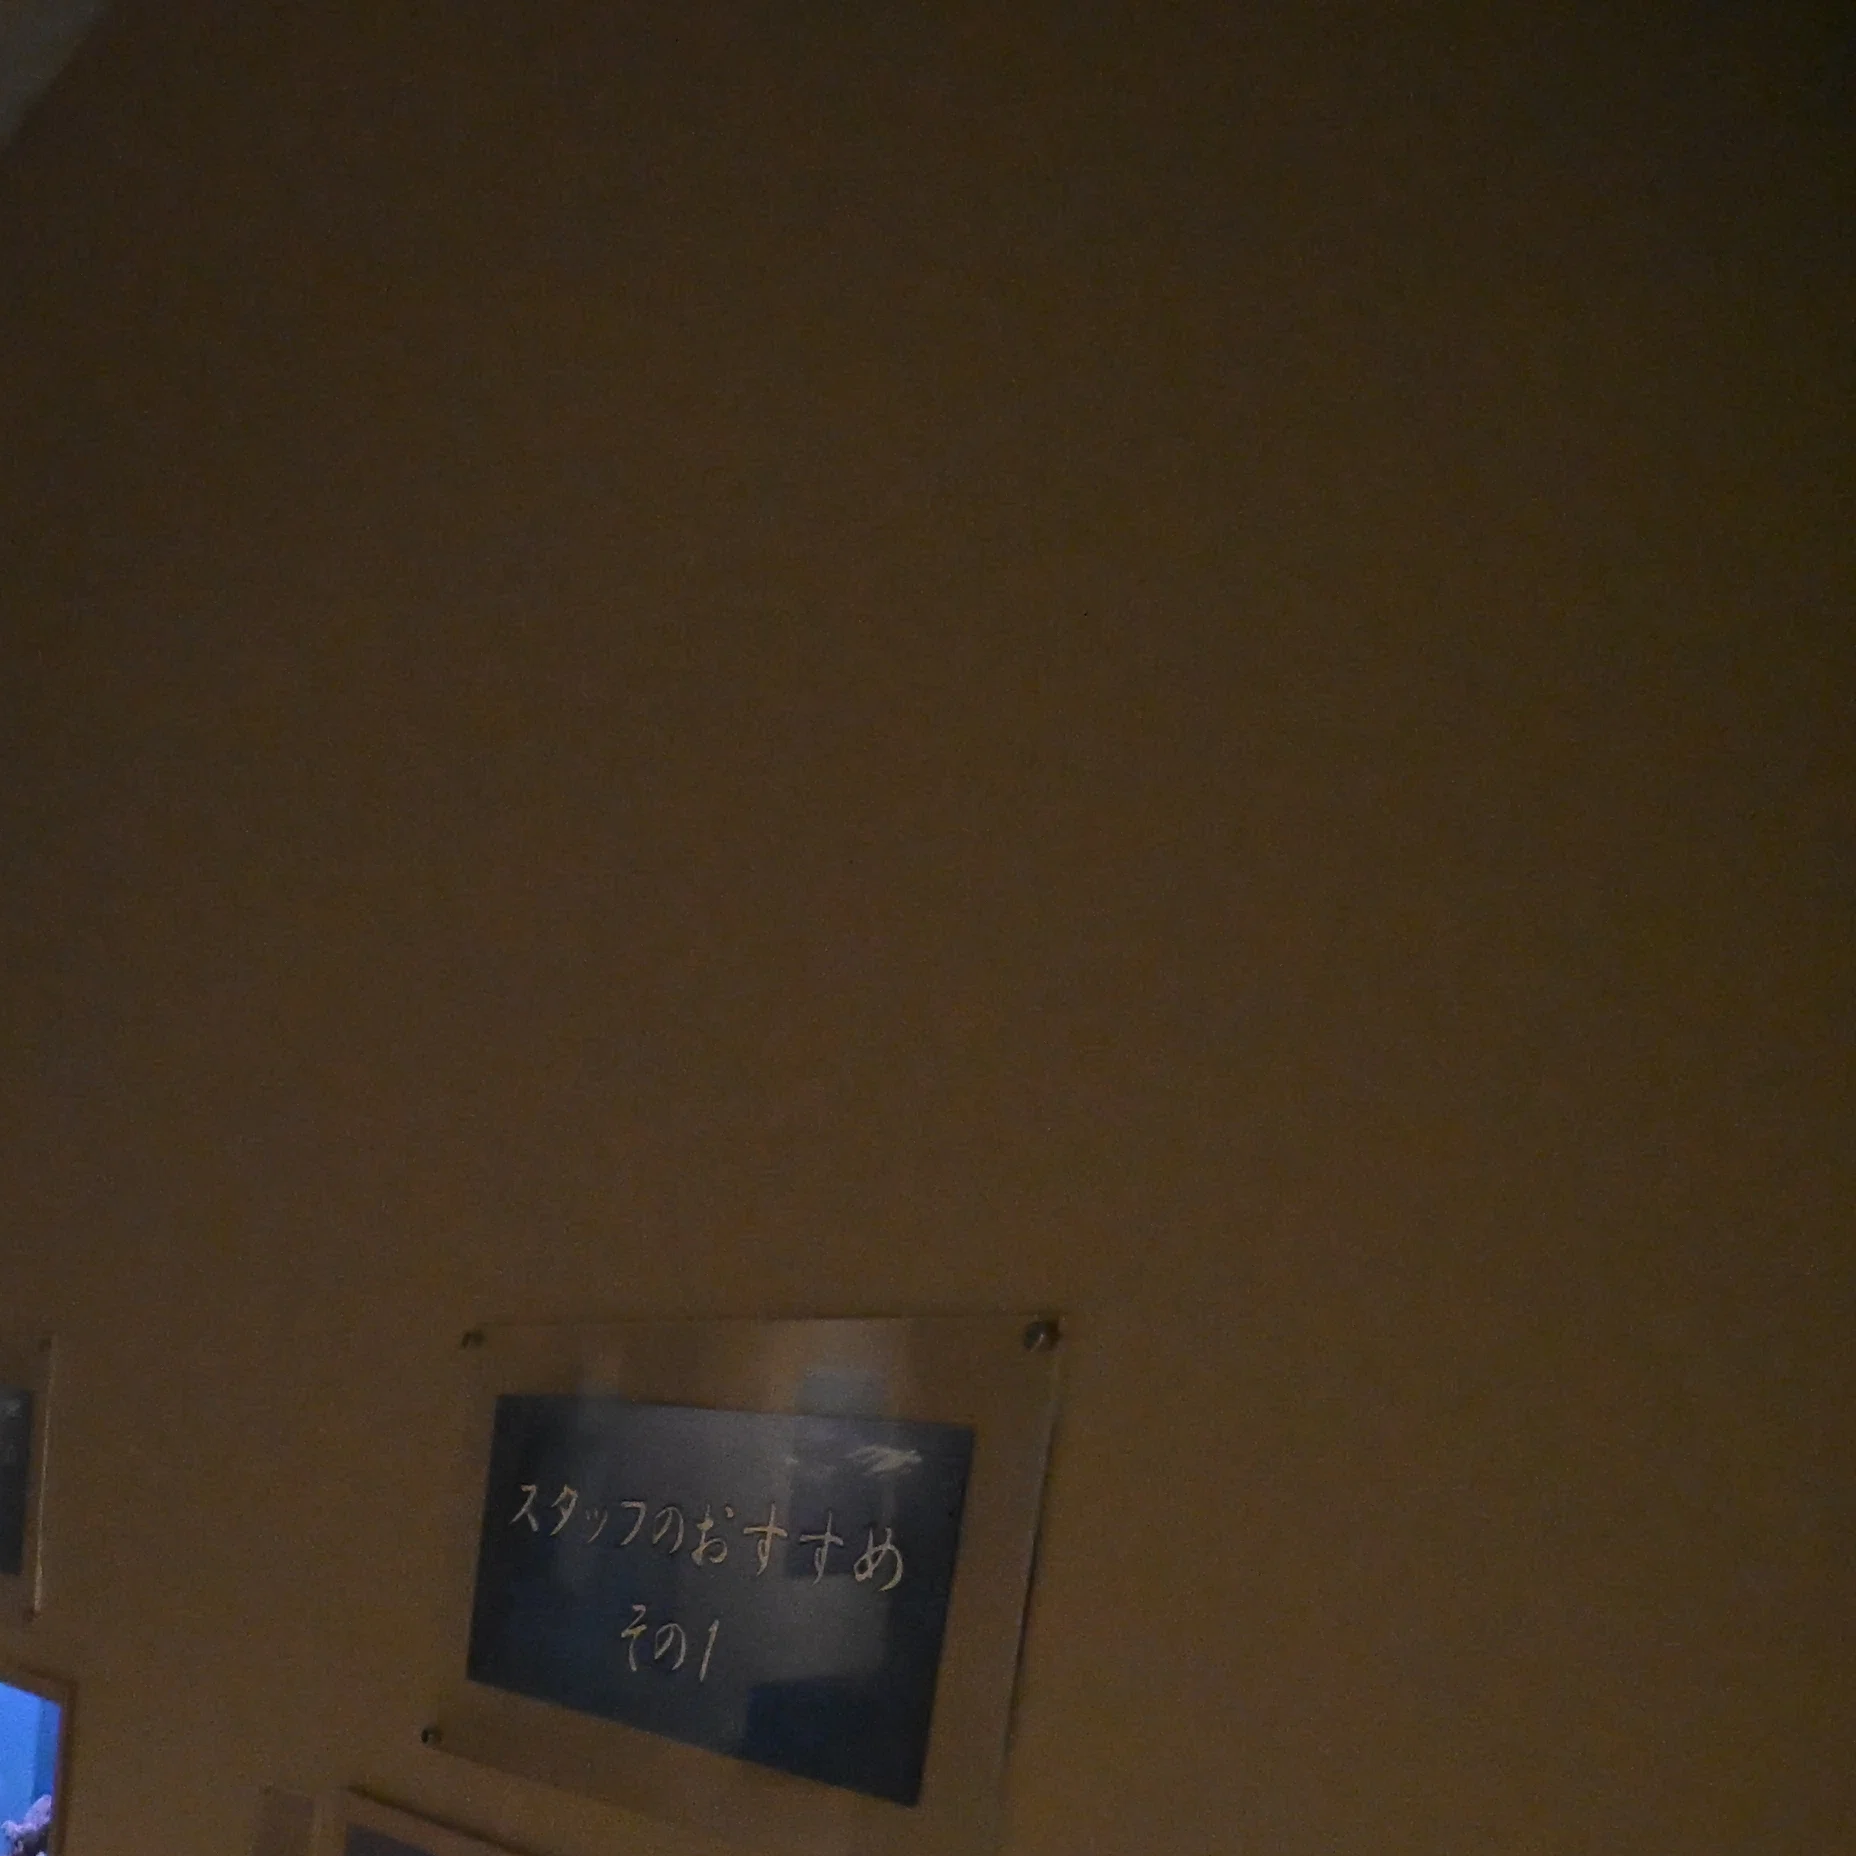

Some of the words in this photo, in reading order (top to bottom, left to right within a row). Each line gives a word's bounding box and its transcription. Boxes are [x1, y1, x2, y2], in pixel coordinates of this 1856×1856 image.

[509, 1484, 904, 1592] スタッフのおすすめ
[621, 1604, 720, 1682] その1
